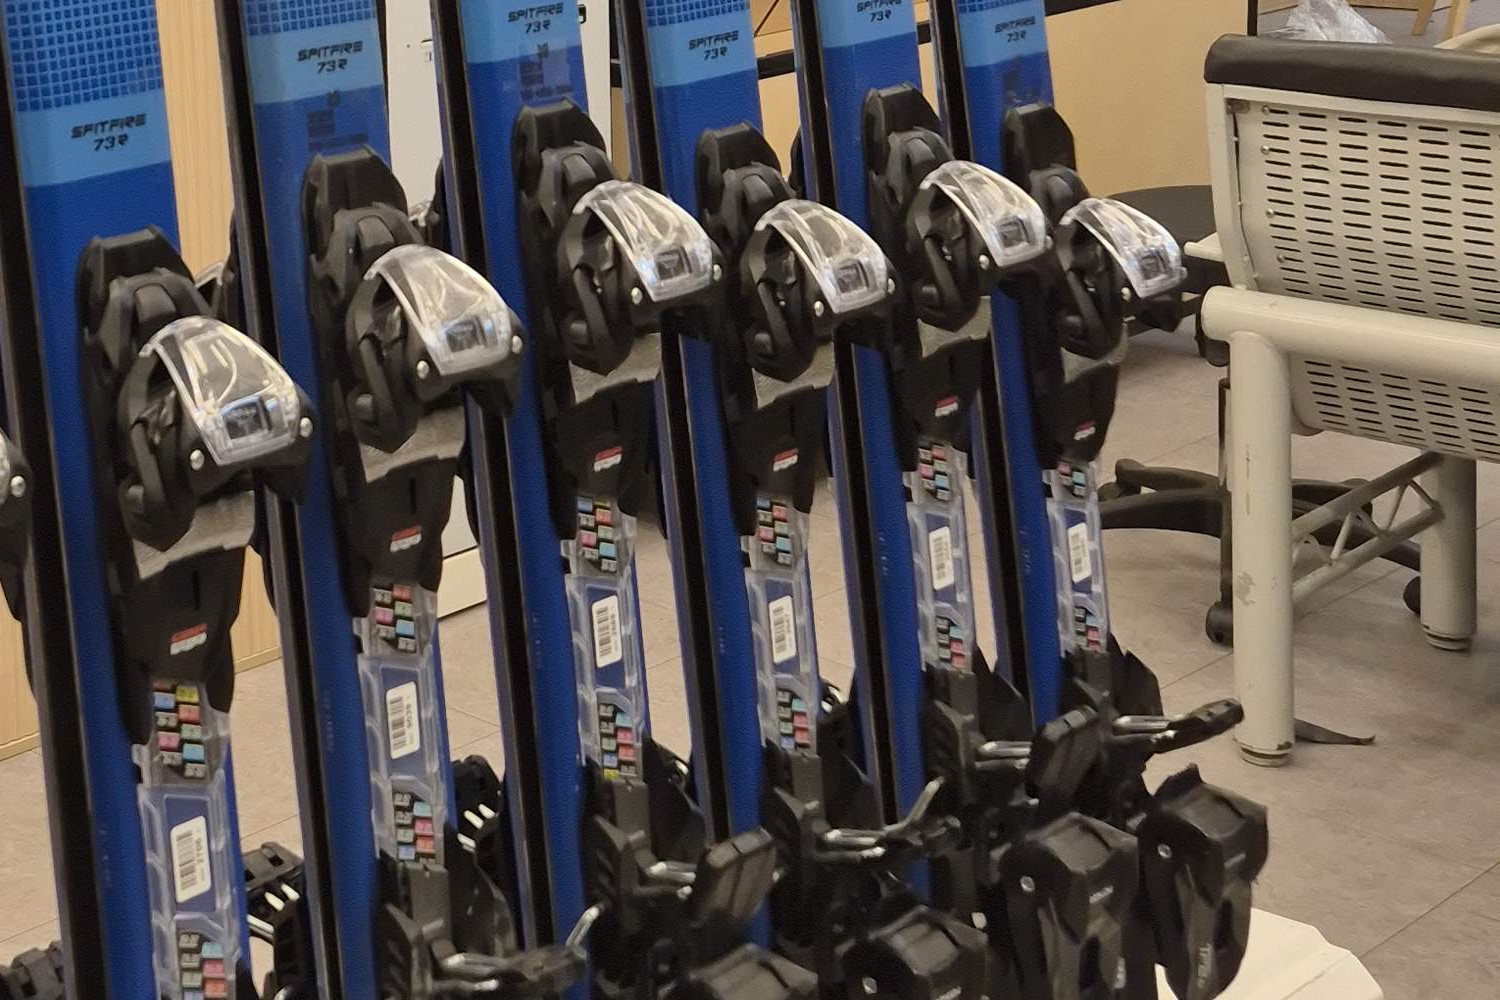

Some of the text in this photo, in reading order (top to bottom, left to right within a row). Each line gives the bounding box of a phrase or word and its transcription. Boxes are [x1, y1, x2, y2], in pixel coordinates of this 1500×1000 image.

[508, 2, 564, 22] SPITFIRE
[688, 29, 740, 50] SPITFIRE
[297, 40, 364, 61] SPITFIRE
[71, 113, 147, 138] SPITFIRE
